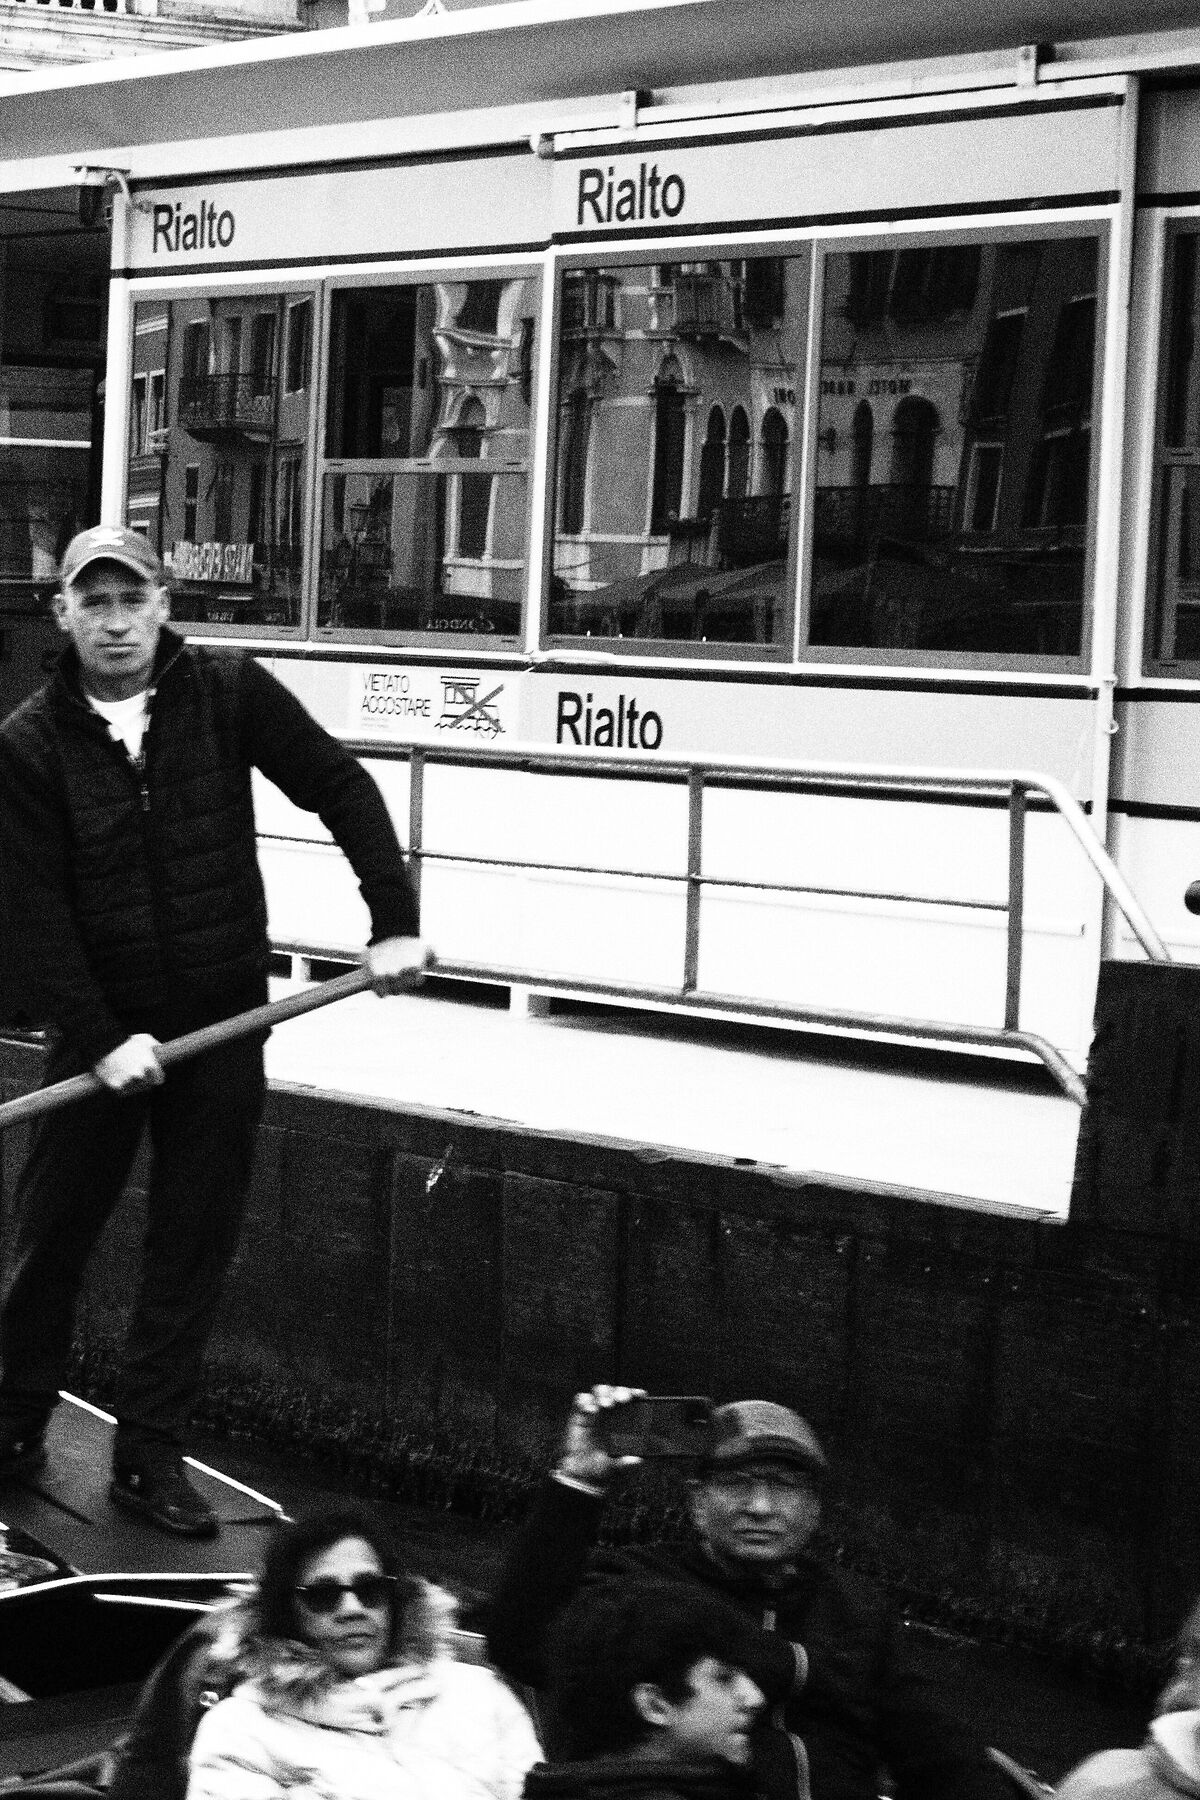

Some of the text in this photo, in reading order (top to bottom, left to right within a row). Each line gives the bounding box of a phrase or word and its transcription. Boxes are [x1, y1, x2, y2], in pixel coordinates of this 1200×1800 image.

[577, 162, 686, 226] Rialto
[152, 199, 236, 253] Rialto
[362, 694, 431, 718] ACCOSTARE
[363, 673, 410, 694] VETATO
[556, 689, 664, 750] Rialto
